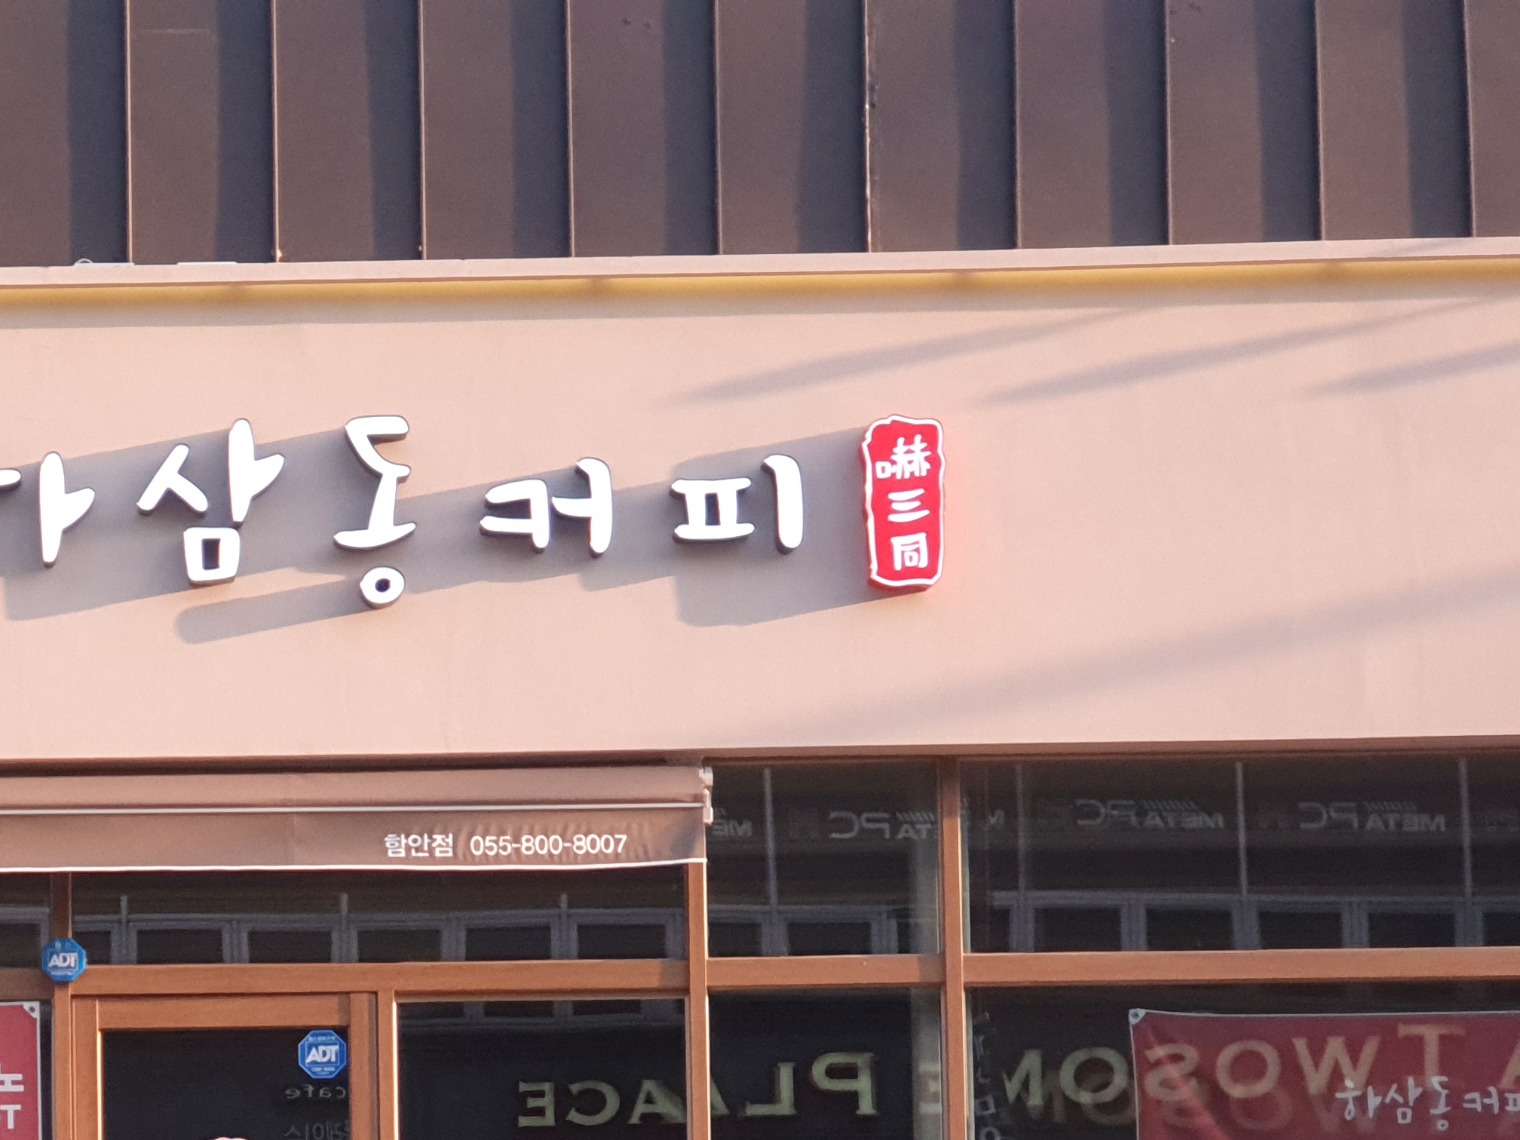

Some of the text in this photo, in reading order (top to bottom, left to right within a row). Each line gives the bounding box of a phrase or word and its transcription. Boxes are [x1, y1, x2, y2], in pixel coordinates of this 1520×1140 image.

[384, 833, 628, 858] 함안점 055-800-8007
[47, 952, 78, 968] ADT
[306, 1045, 339, 1063] ADT
